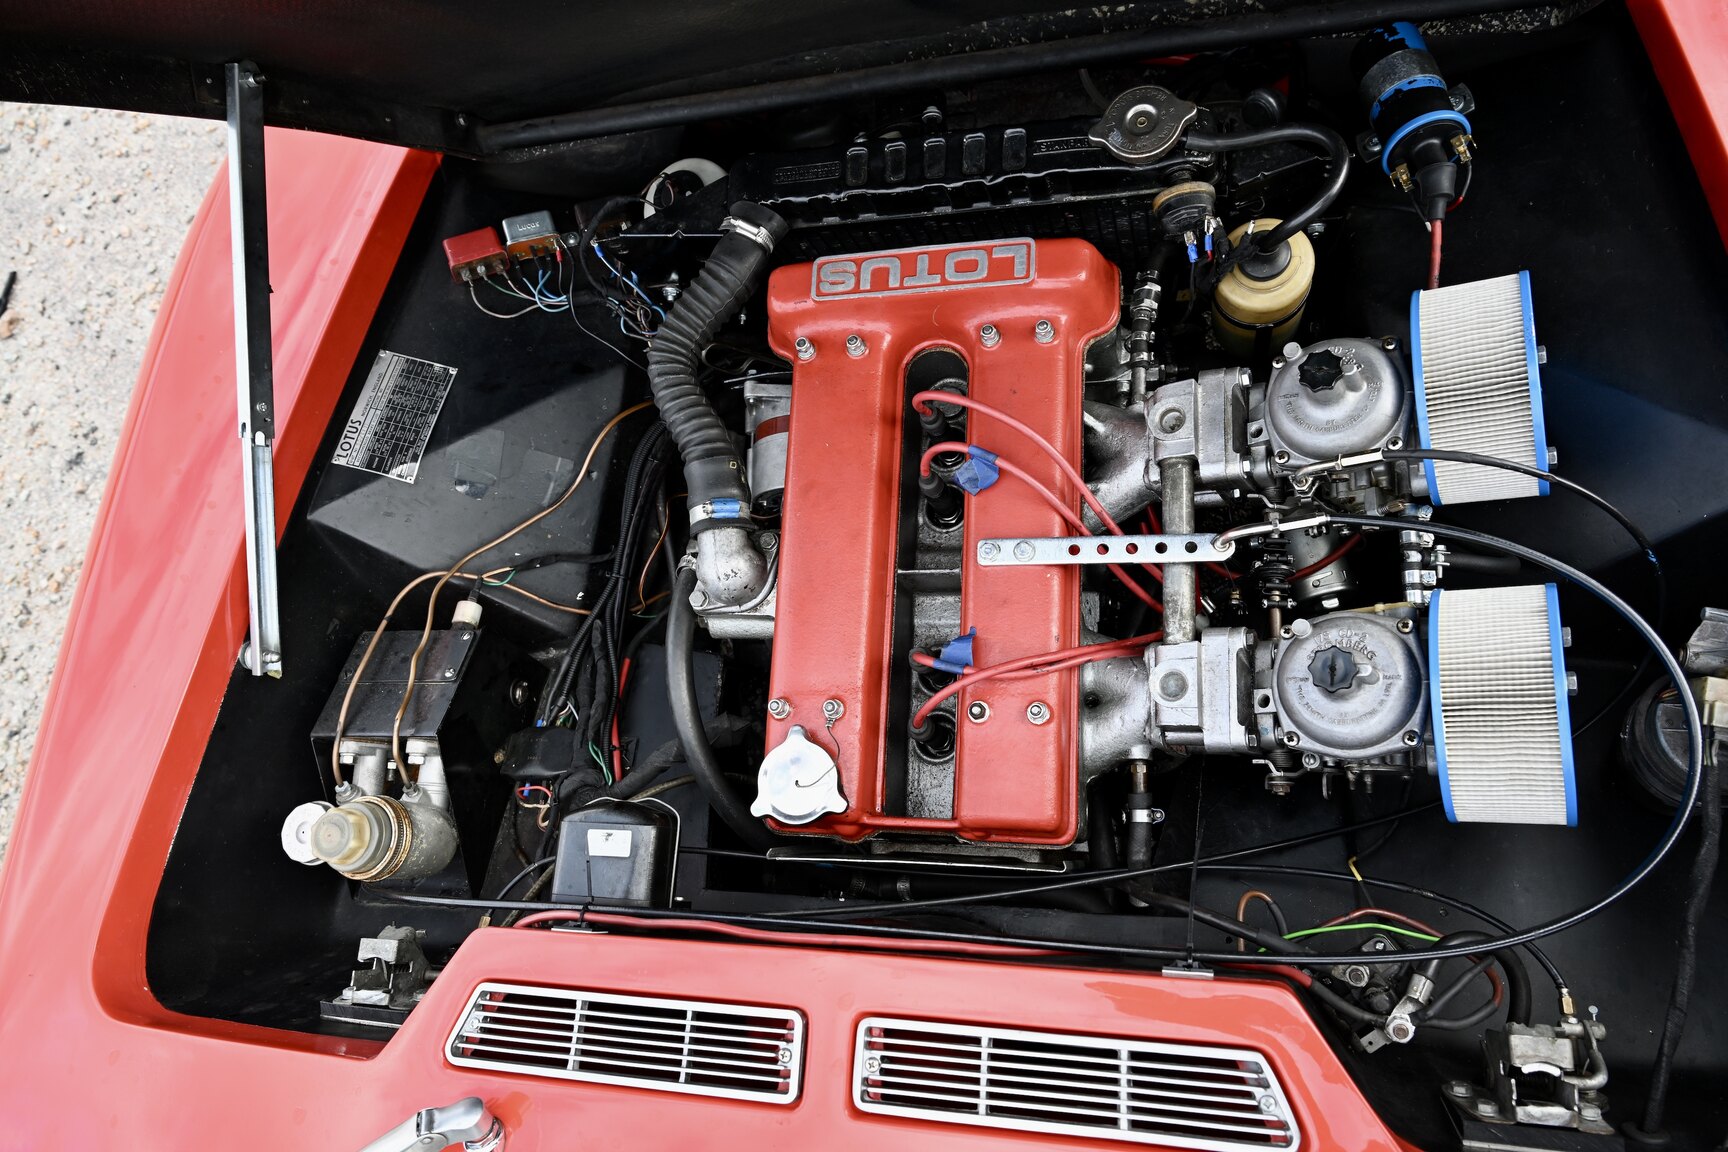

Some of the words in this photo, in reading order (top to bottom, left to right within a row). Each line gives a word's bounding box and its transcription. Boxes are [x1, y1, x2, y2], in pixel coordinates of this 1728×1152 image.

[516, 221, 540, 232] Lucas
[819, 244, 1027, 293] LOTUS
[337, 418, 361, 458] LOTUS
[1338, 627, 1369, 643] CD-2
